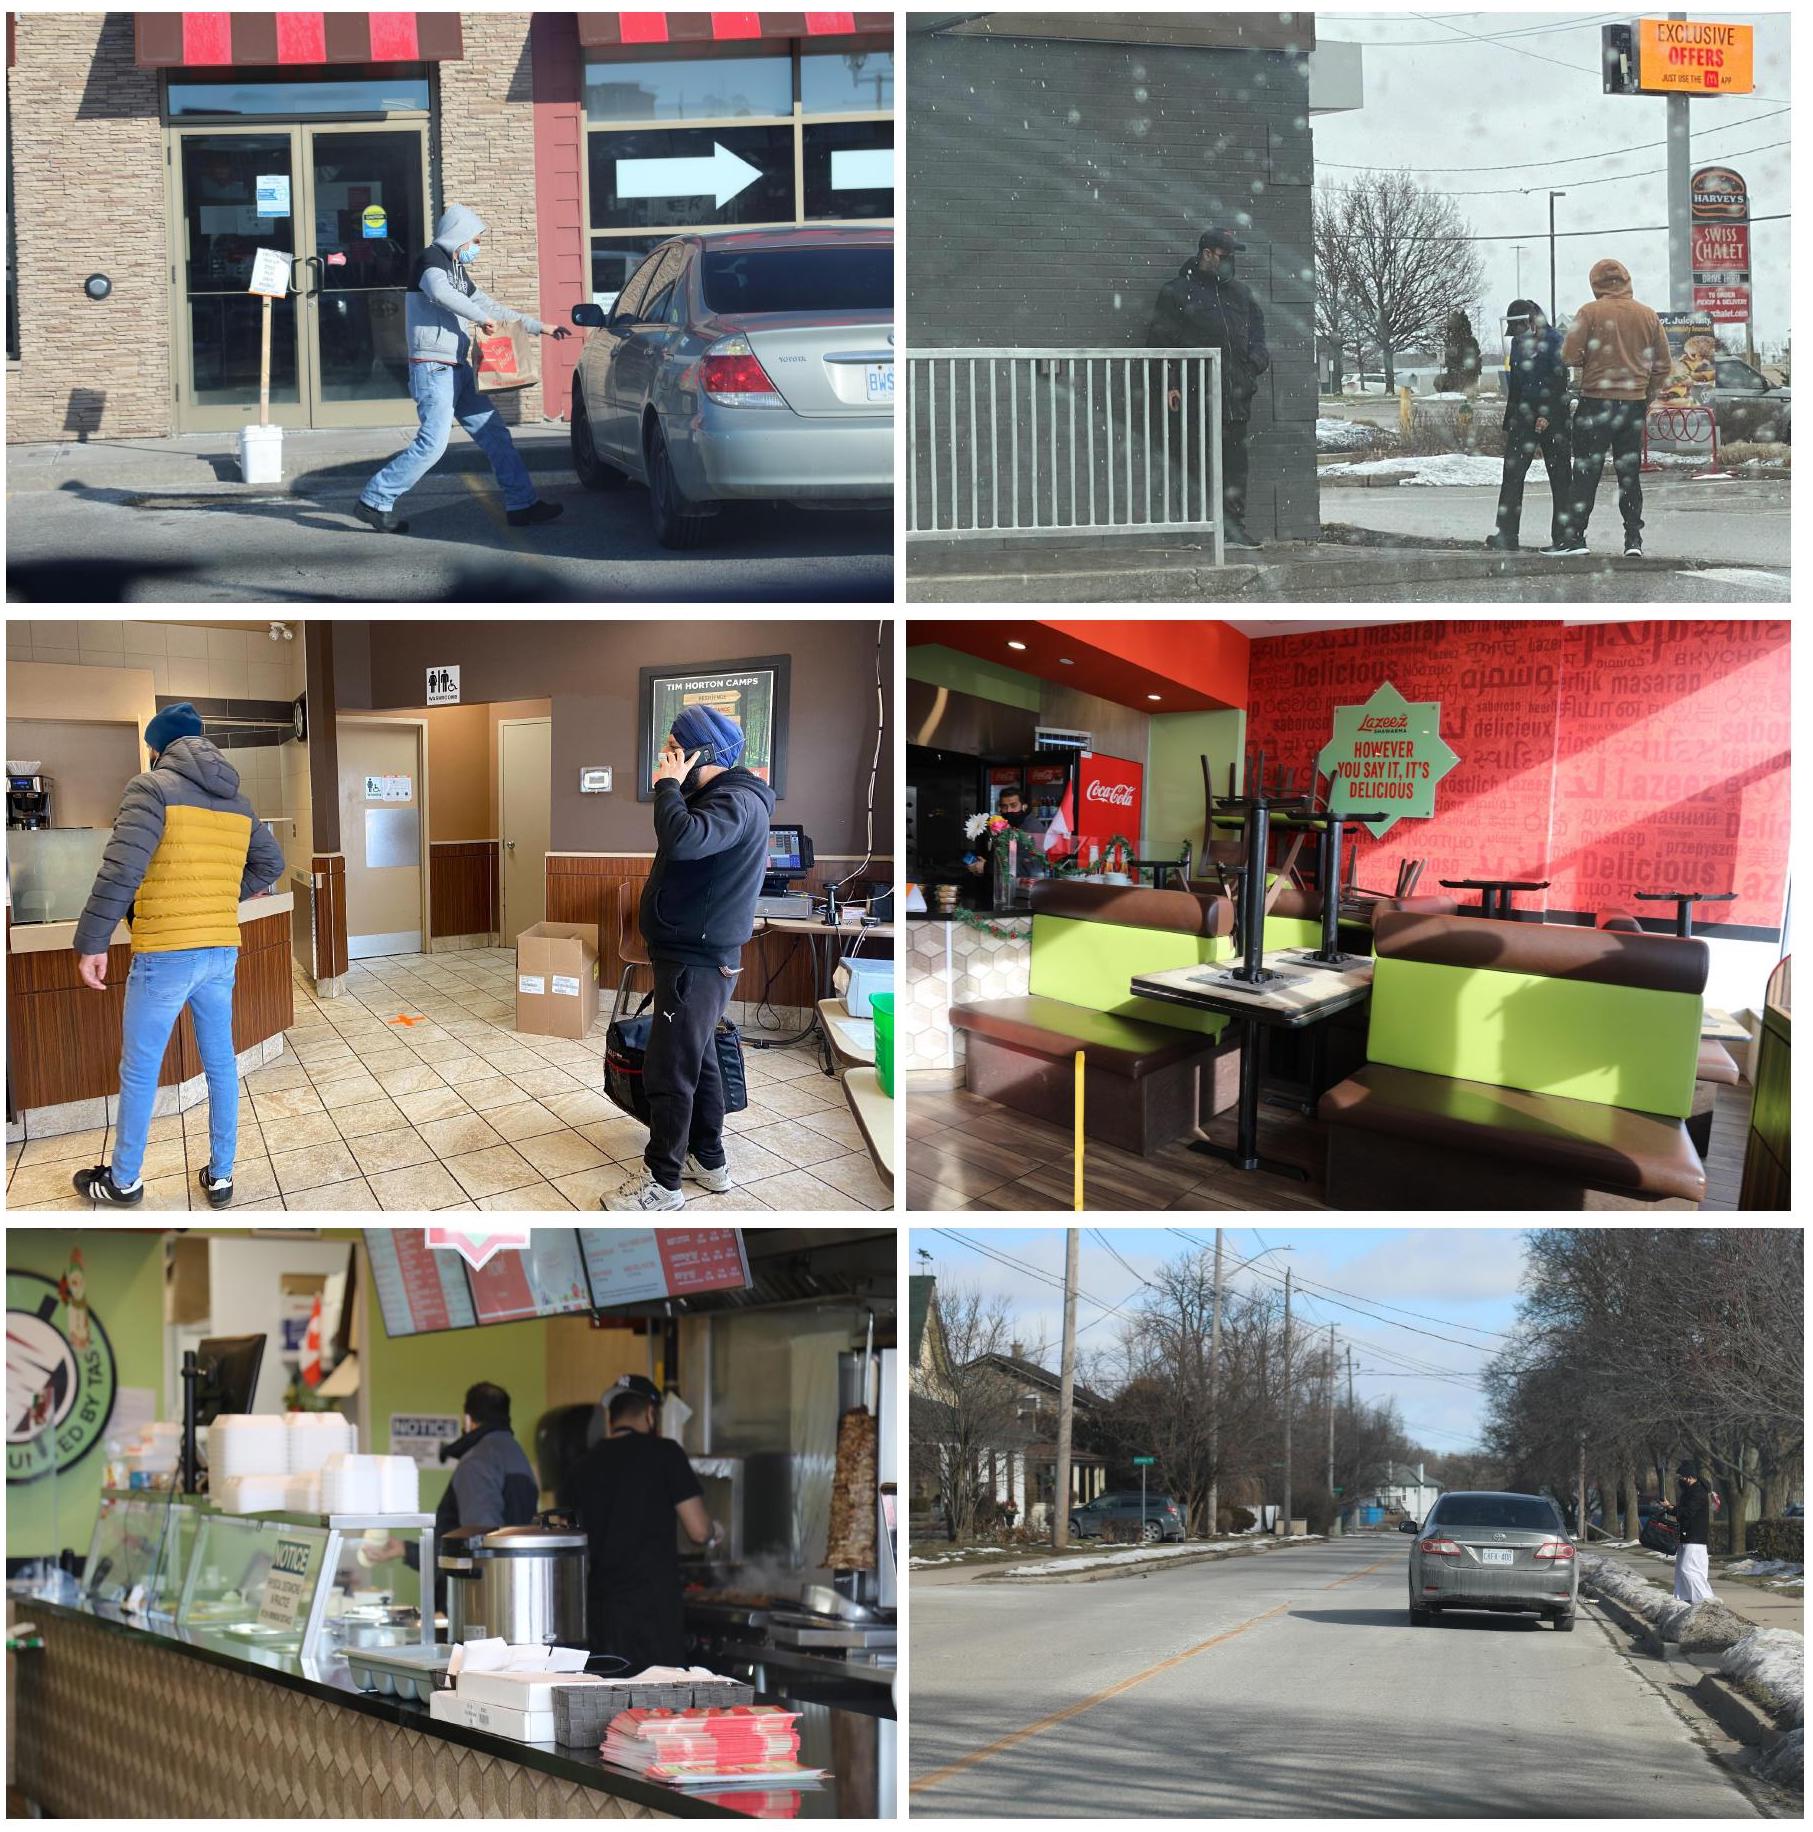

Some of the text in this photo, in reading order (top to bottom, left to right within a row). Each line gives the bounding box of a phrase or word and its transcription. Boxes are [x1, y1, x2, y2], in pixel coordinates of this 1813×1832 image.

[1658, 24, 1735, 45] EXCLUSIVE
[1668, 46, 1724, 67] OFFERS
[1662, 74, 1676, 82] JUST
[1678, 75, 1689, 83] USE
[1690, 75, 1702, 83] THE
[1721, 76, 1732, 84] APP
[1705, 228, 1737, 241] SWISS
[1696, 240, 1744, 262] CHALET
[1702, 274, 1722, 283] DRIVE
[1293, 653, 1399, 688] Delicious
[685, 680, 723, 690] HORTON
[726, 677, 759, 686] CAMPS
[1611, 673, 1702, 695] masarap
[1474, 717, 1553, 738] délicieux
[1354, 741, 1414, 758] HOWEVER
[1338, 762, 1430, 781] YOU SAY IT, IT'S
[1087, 779, 1136, 807] Coca-Cola
[1349, 781, 1414, 798] DELICIOUS
[1440, 775, 1498, 794] köstlich
[1581, 851, 1717, 887] Delicious
[80, 1393, 101, 1423] BY
[395, 1421, 455, 1436] NOTICE
[272, 1543, 311, 1572] NOTICE
